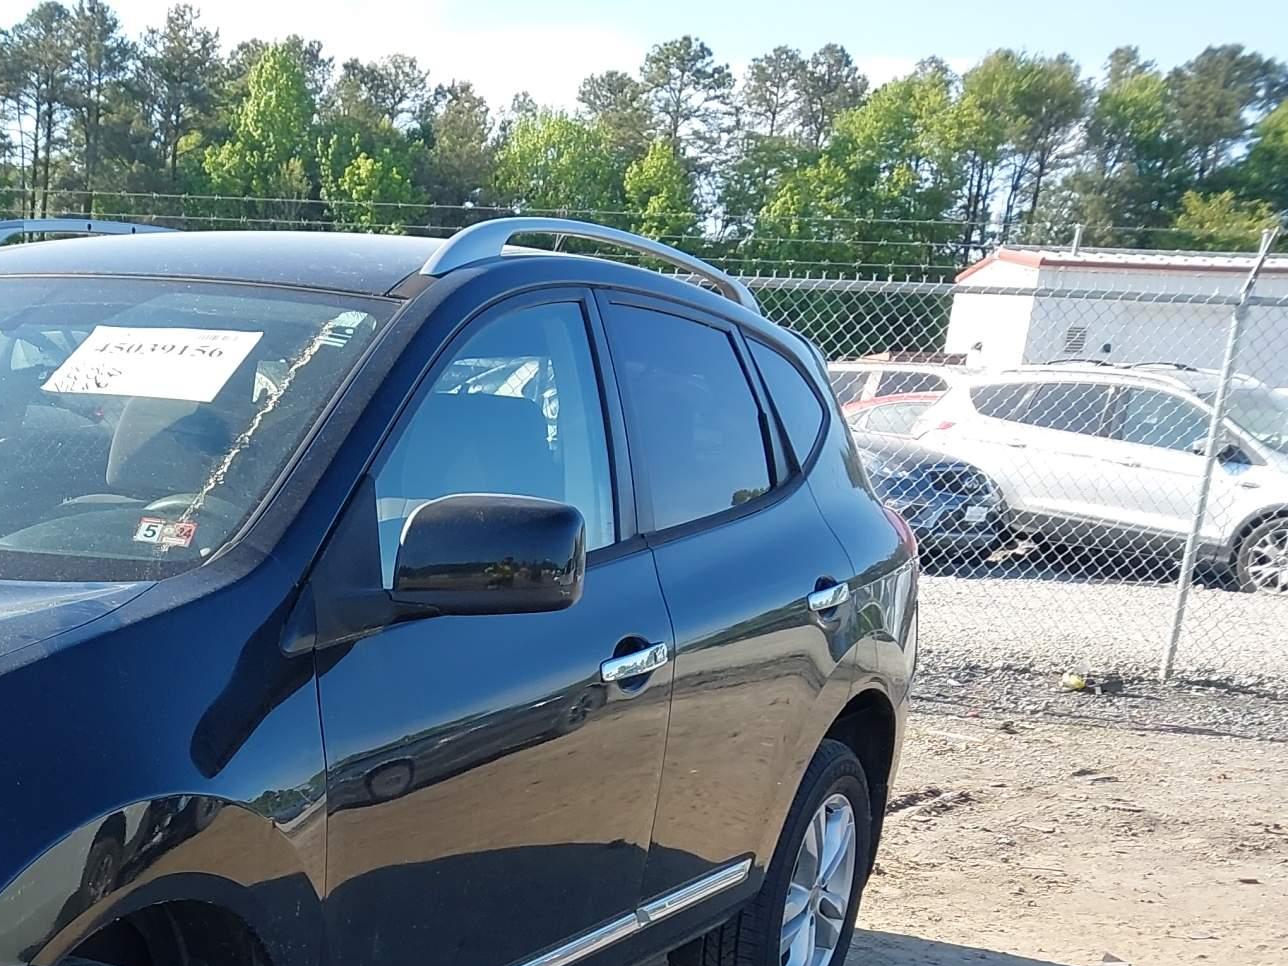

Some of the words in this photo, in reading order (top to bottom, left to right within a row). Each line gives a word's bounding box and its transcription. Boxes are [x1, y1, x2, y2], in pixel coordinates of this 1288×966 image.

[93, 341, 225, 359] 45039156
[143, 524, 159, 538] 5
[175, 527, 193, 539] 24
